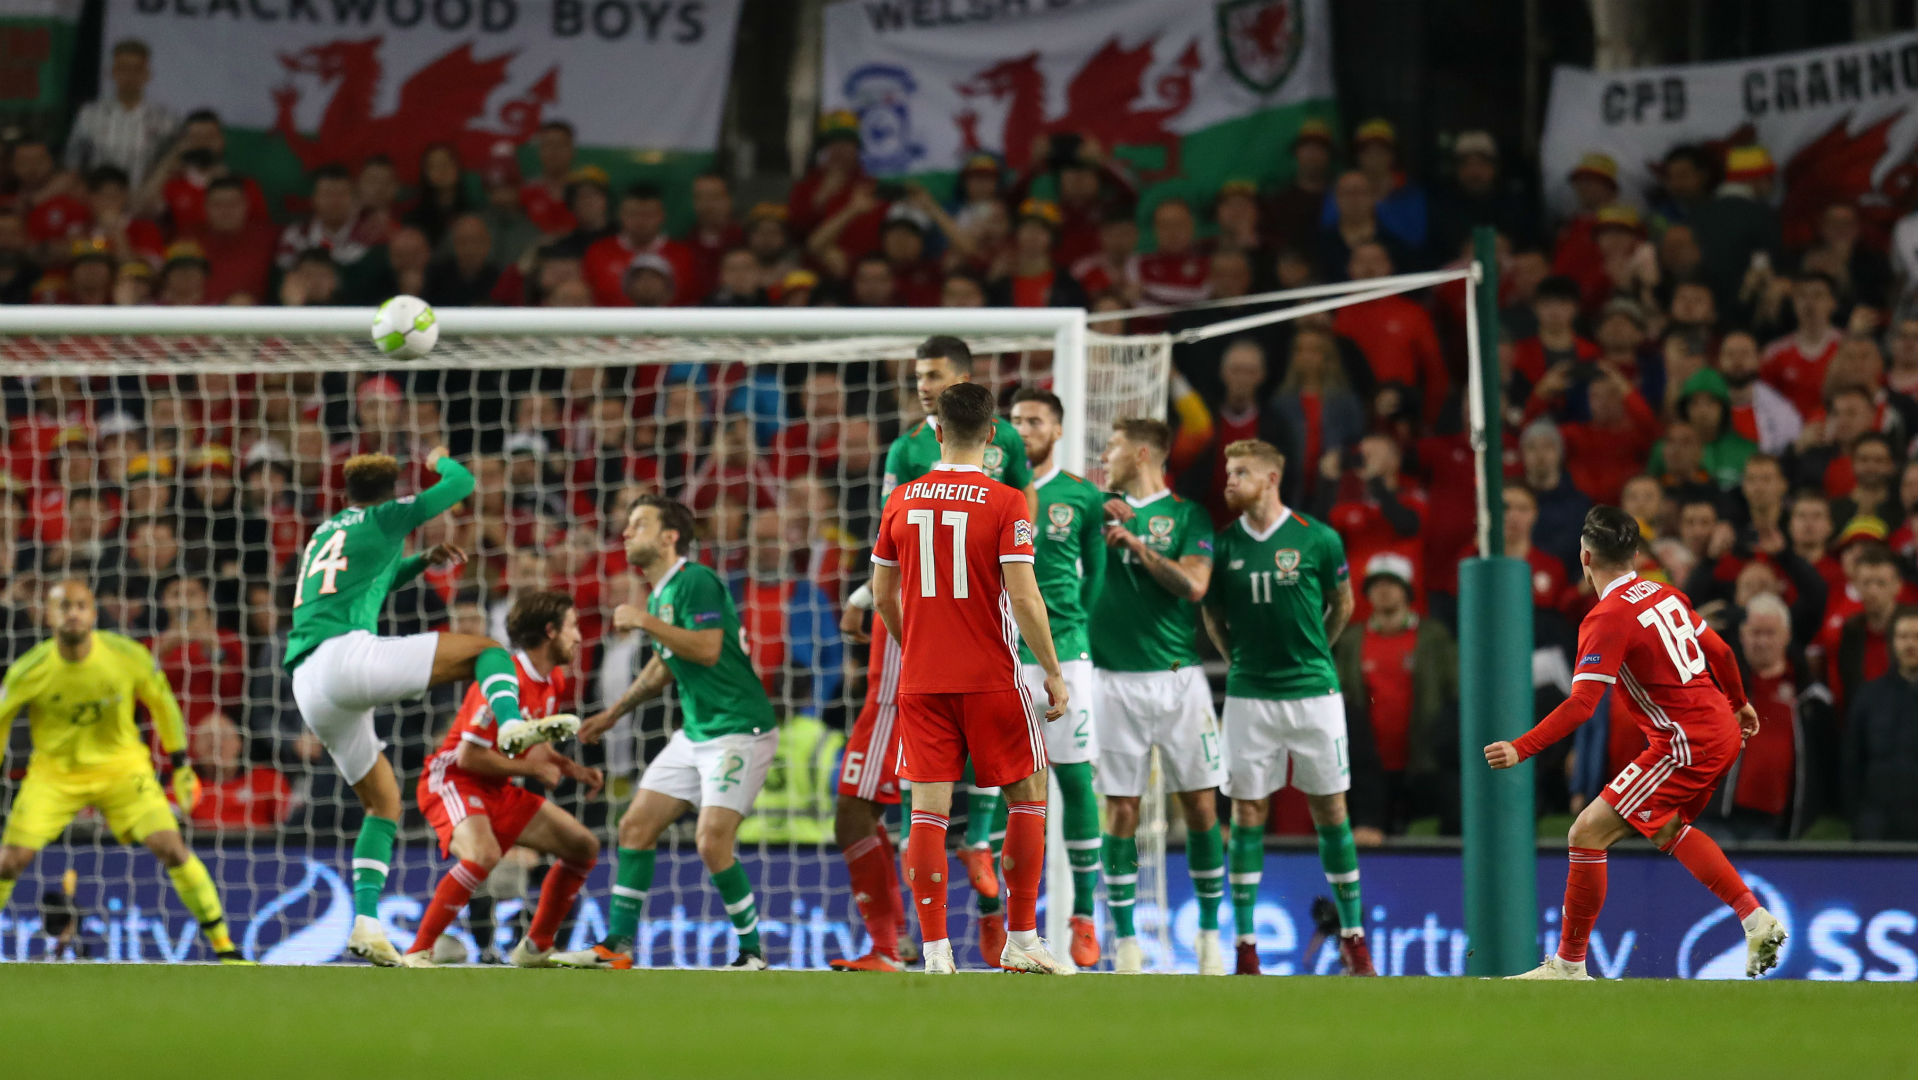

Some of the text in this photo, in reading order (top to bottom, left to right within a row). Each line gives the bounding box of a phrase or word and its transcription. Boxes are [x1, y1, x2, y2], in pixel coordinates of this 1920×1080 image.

[552, 0, 706, 43] BOYS
[904, 482, 989, 504] LAWRENCE
[293, 529, 348, 608] 14
[907, 509, 969, 599] 11
[1250, 571, 1271, 603] 11
[1620, 580, 1663, 604] WILSON
[1636, 594, 1706, 685] 18
[1073, 709, 1089, 738] 2
[842, 751, 864, 785] 6
[1609, 762, 1643, 795] 8
